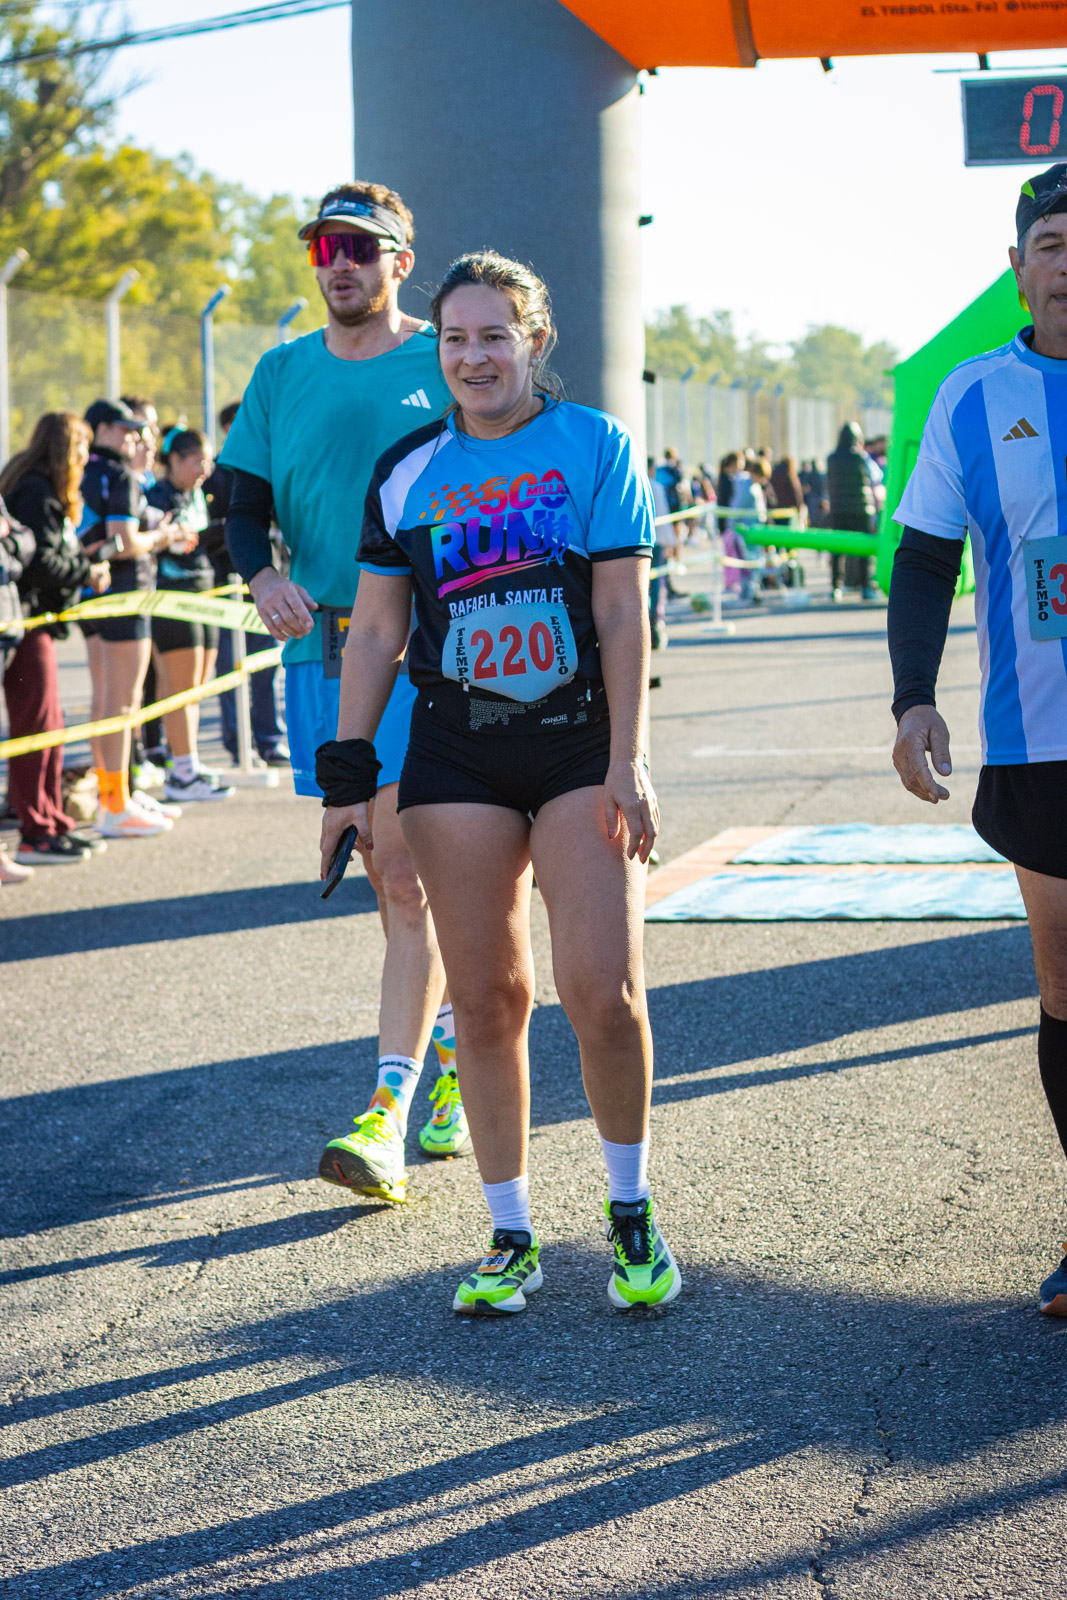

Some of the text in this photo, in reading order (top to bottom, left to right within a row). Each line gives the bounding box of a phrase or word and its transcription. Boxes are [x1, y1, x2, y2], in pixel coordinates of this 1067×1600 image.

[1019, 84, 1064, 155] 0
[430, 510, 556, 579] RUN
[505, 588, 547, 606] SANTA
[551, 587, 564, 603] FE
[1034, 559, 1049, 621] TIEMPO
[470, 621, 555, 680] 220
[550, 616, 568, 675] EXACTO
